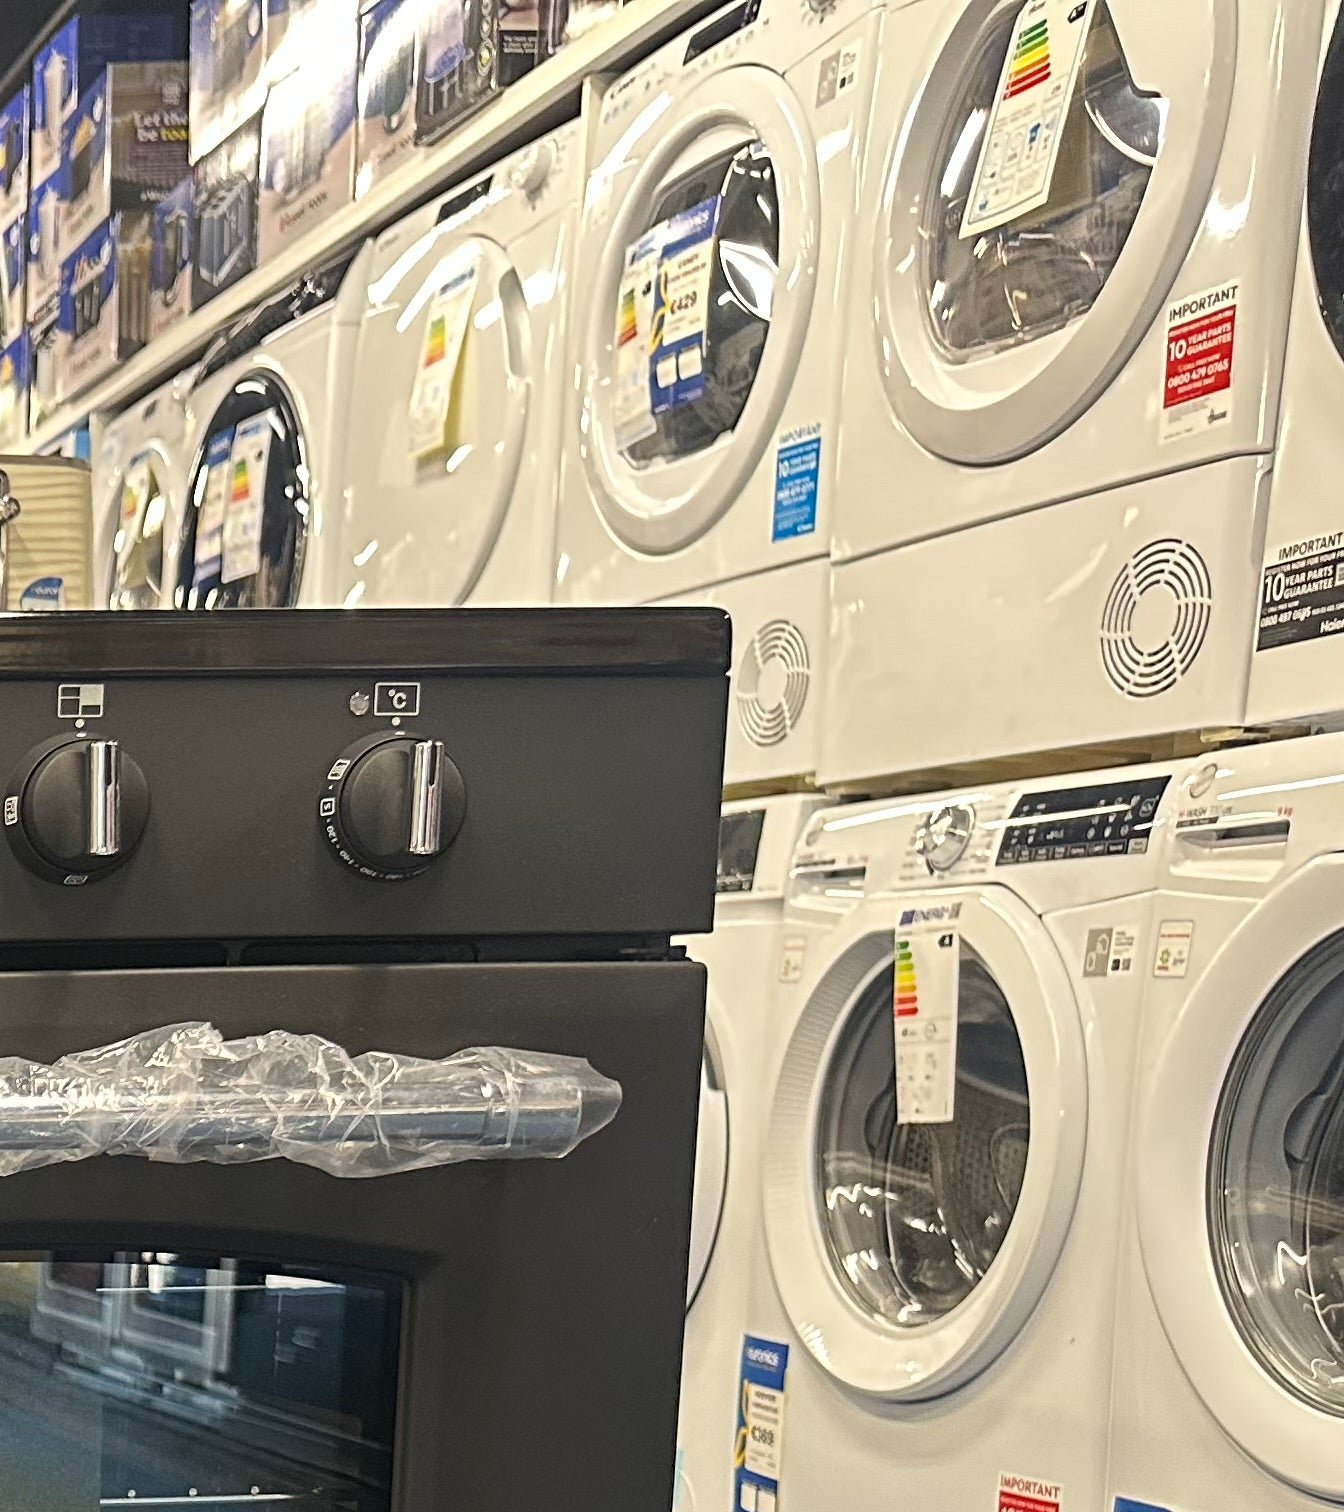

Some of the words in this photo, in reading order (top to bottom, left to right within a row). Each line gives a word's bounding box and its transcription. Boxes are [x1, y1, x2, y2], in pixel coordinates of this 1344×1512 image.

[1169, 285, 1239, 322] IMPORTANT
[1168, 338, 1187, 362] 10
[1278, 531, 1343, 560] IMPORTANT
[1265, 572, 1285, 603] 10
[1285, 572, 1306, 587] YEAR
[1307, 565, 1333, 580] PARTS
[1284, 577, 1334, 599] GUARANTEE
[1320, 618, 1344, 634] Haier
[1000, 1474, 1060, 1499] IMPORTANT
